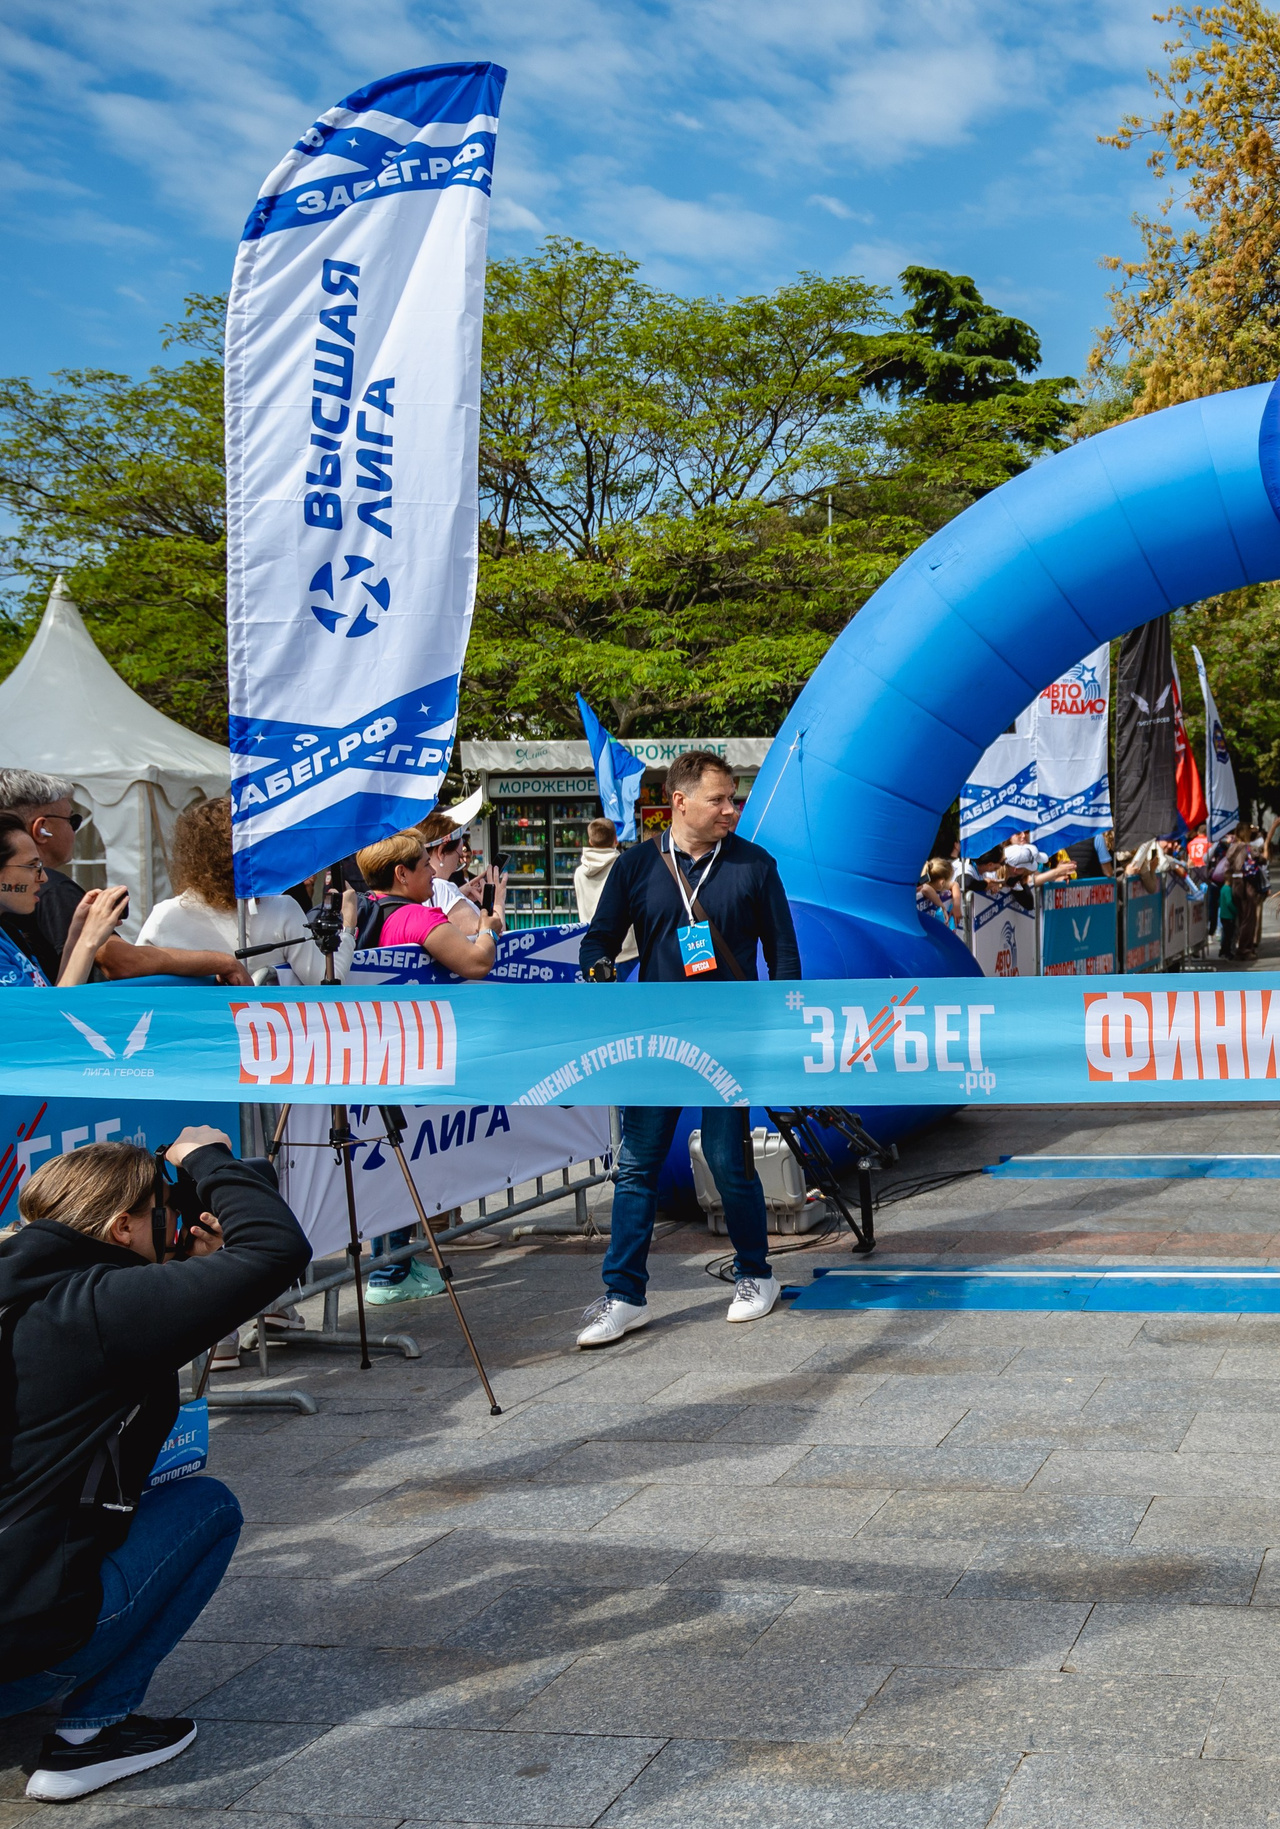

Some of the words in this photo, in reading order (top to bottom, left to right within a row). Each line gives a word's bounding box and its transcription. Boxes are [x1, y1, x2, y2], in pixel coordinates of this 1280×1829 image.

[304, 258, 360, 531] ВЫСШАЯ
[356, 376, 395, 540] ЛИГА
[1051, 698, 1106, 715] РАДИО
[499, 778, 597, 795] МОРОЖЕНОЕ
[960, 783, 1017, 823] АБЕГ.РФ
[1191, 843, 1204, 858] 13
[354, 949, 434, 969] ЗАБЕГ.Р
[486, 961, 554, 982] АБЕГ.РФ
[229, 1001, 457, 1086] ФИНИШ
[83, 1067, 110, 1077] ЛИГА
[113, 1067, 155, 1078] ГЕРОЕВ
[581, 1035, 645, 1077] #ТРЕПЕТ
[648, 1034, 743, 1103] #УДИВЛЕНИЕ
[410, 1104, 511, 1162] ЛИГА
[150, 1460, 202, 1487] ФОТОГРАФ
